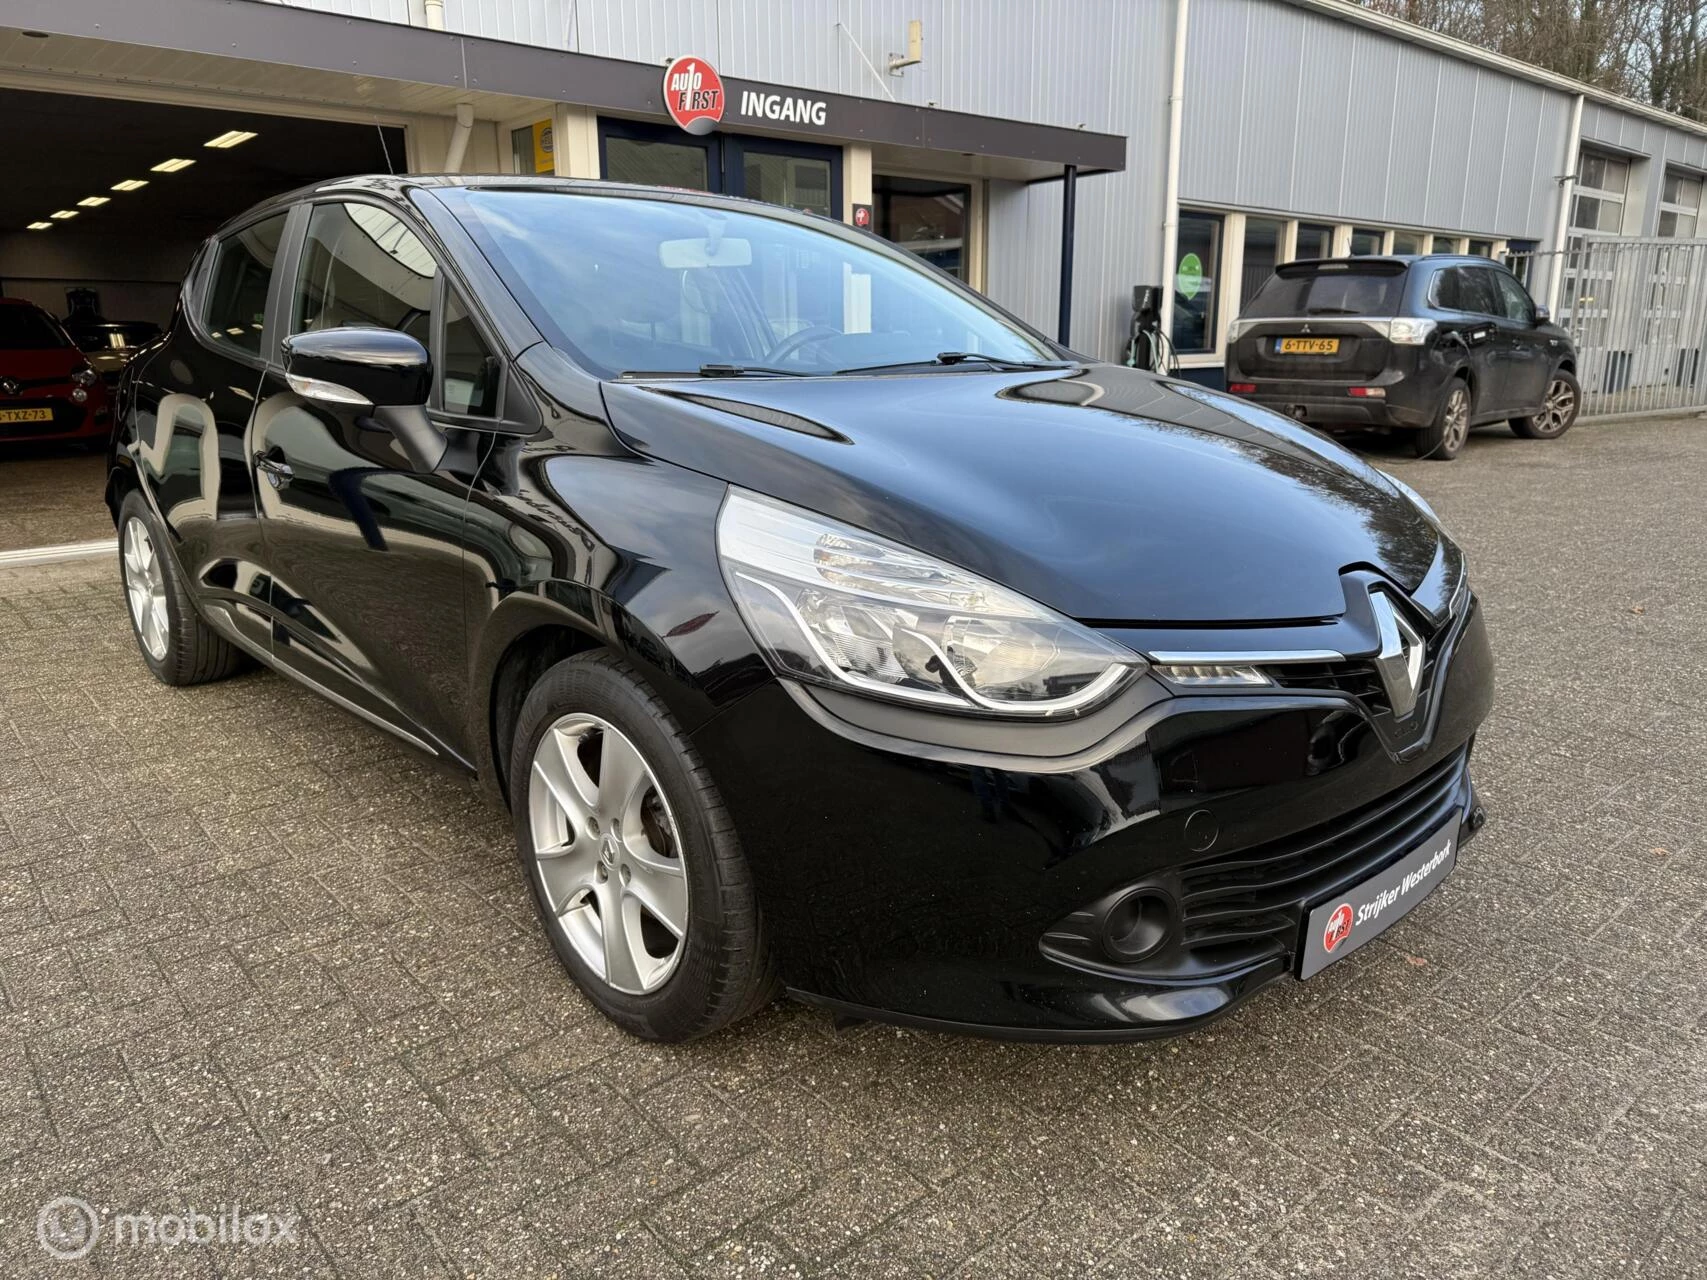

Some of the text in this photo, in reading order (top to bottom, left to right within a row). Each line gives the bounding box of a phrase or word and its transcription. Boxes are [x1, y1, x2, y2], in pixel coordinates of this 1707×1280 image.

[740, 91, 827, 126] INGANG
[1284, 340, 1333, 350] 6-TTV-65
[0, 409, 46, 421] -TXZ-73
[1355, 839, 1451, 926] Strijker Westerbork
